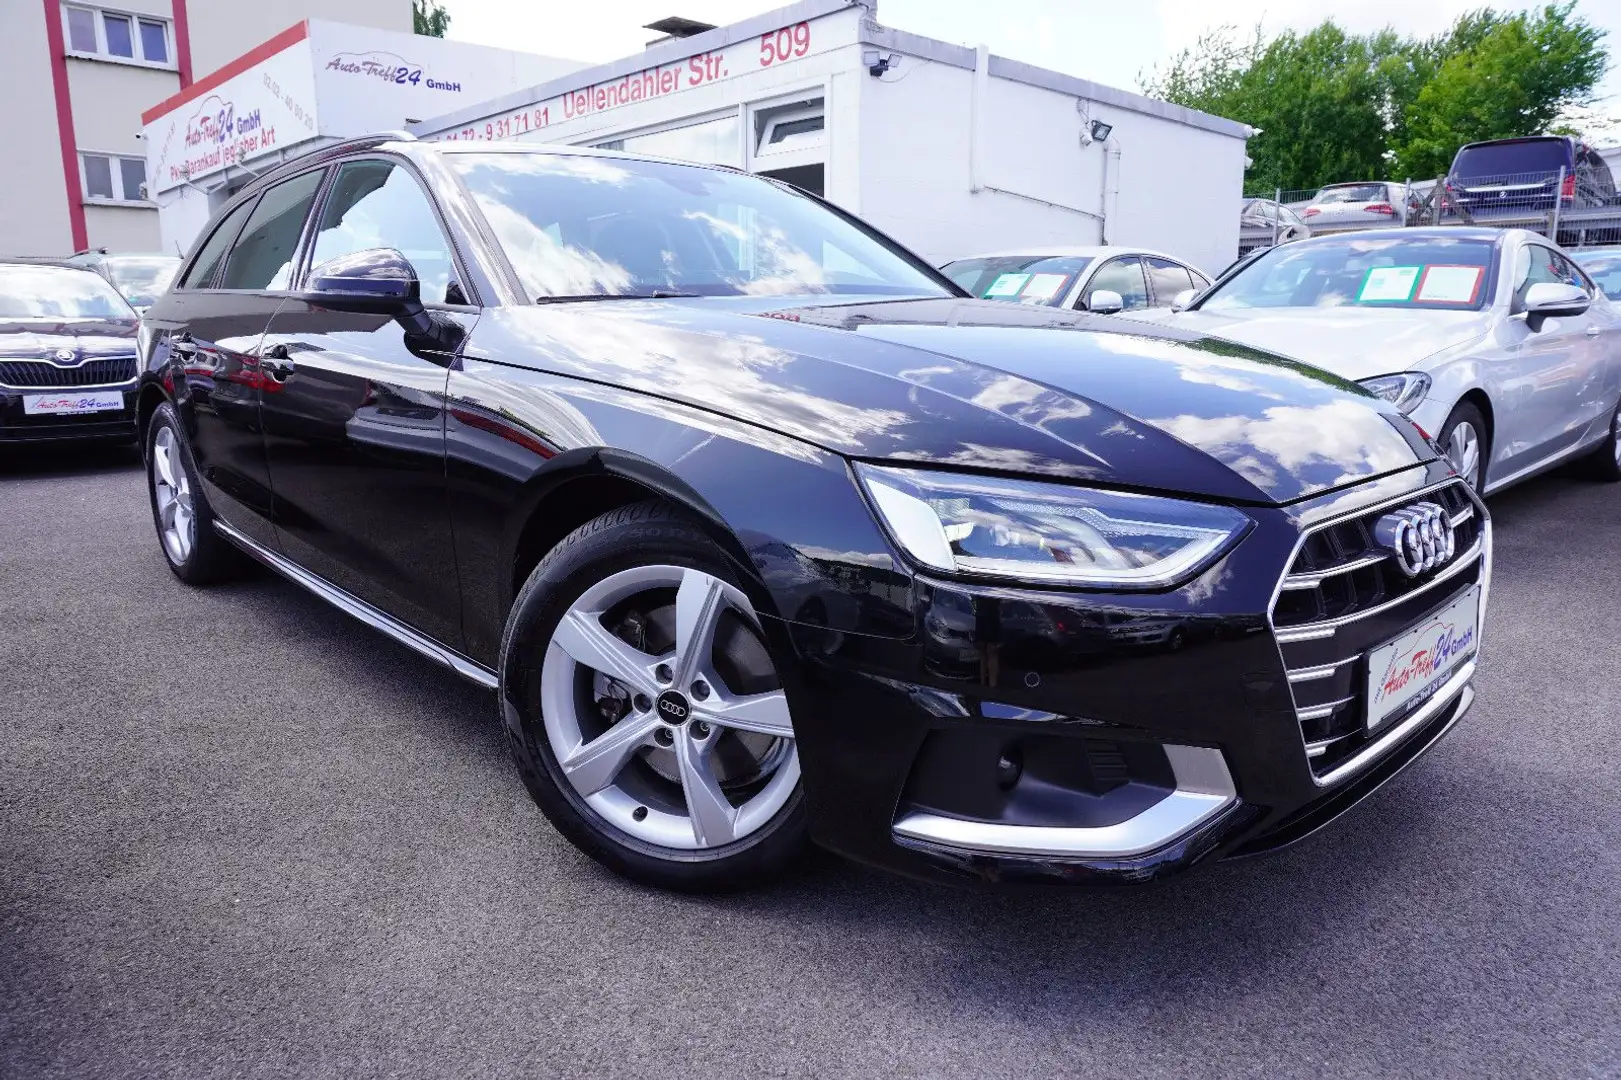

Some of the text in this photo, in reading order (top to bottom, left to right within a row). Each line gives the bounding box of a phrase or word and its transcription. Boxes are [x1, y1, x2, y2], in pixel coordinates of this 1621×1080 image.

[563, 21, 811, 119] Uellendahler Str. 509
[426, 78, 461, 92] GmbH
[237, 108, 262, 135] GmbH
[486, 123, 493, 140] 9
[496, 117, 510, 137] 31
[514, 113, 528, 133] 71
[534, 107, 549, 128] 81
[261, 125, 275, 148] Art
[1451, 625, 1472, 656] GmbH
